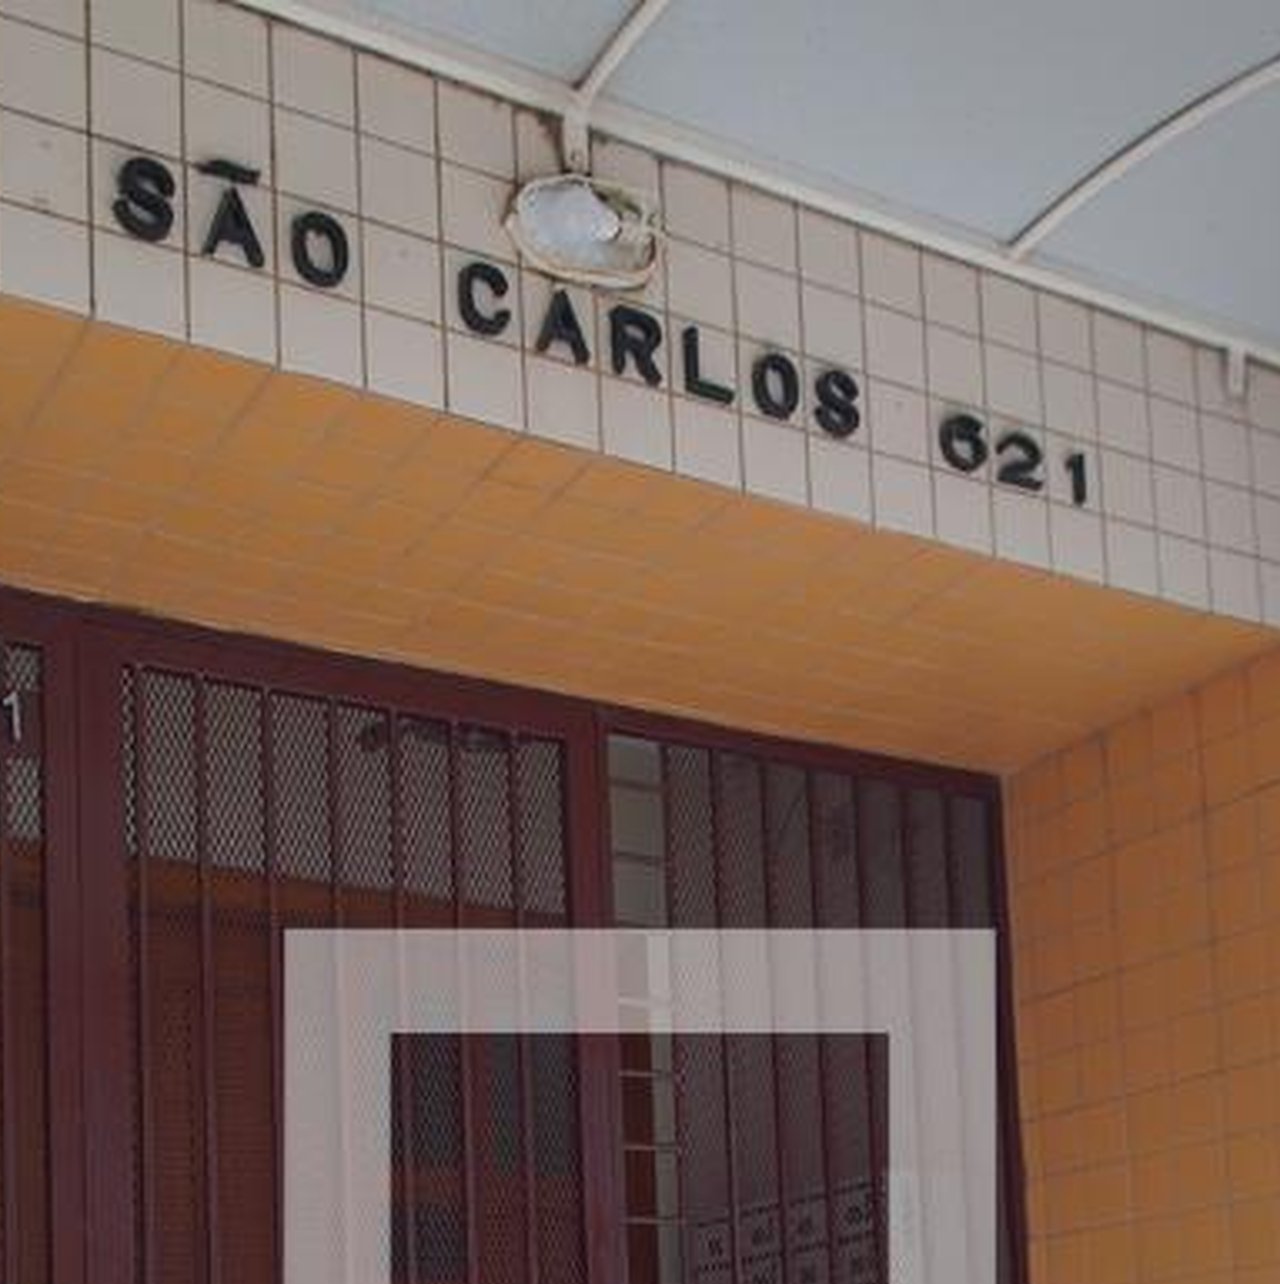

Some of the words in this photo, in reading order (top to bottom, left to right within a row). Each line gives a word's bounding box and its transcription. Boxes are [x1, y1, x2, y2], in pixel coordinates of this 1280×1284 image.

[111, 157, 350, 289] SÃO
[456, 261, 861, 438] CARLOS
[938, 412, 1089, 507] 621
